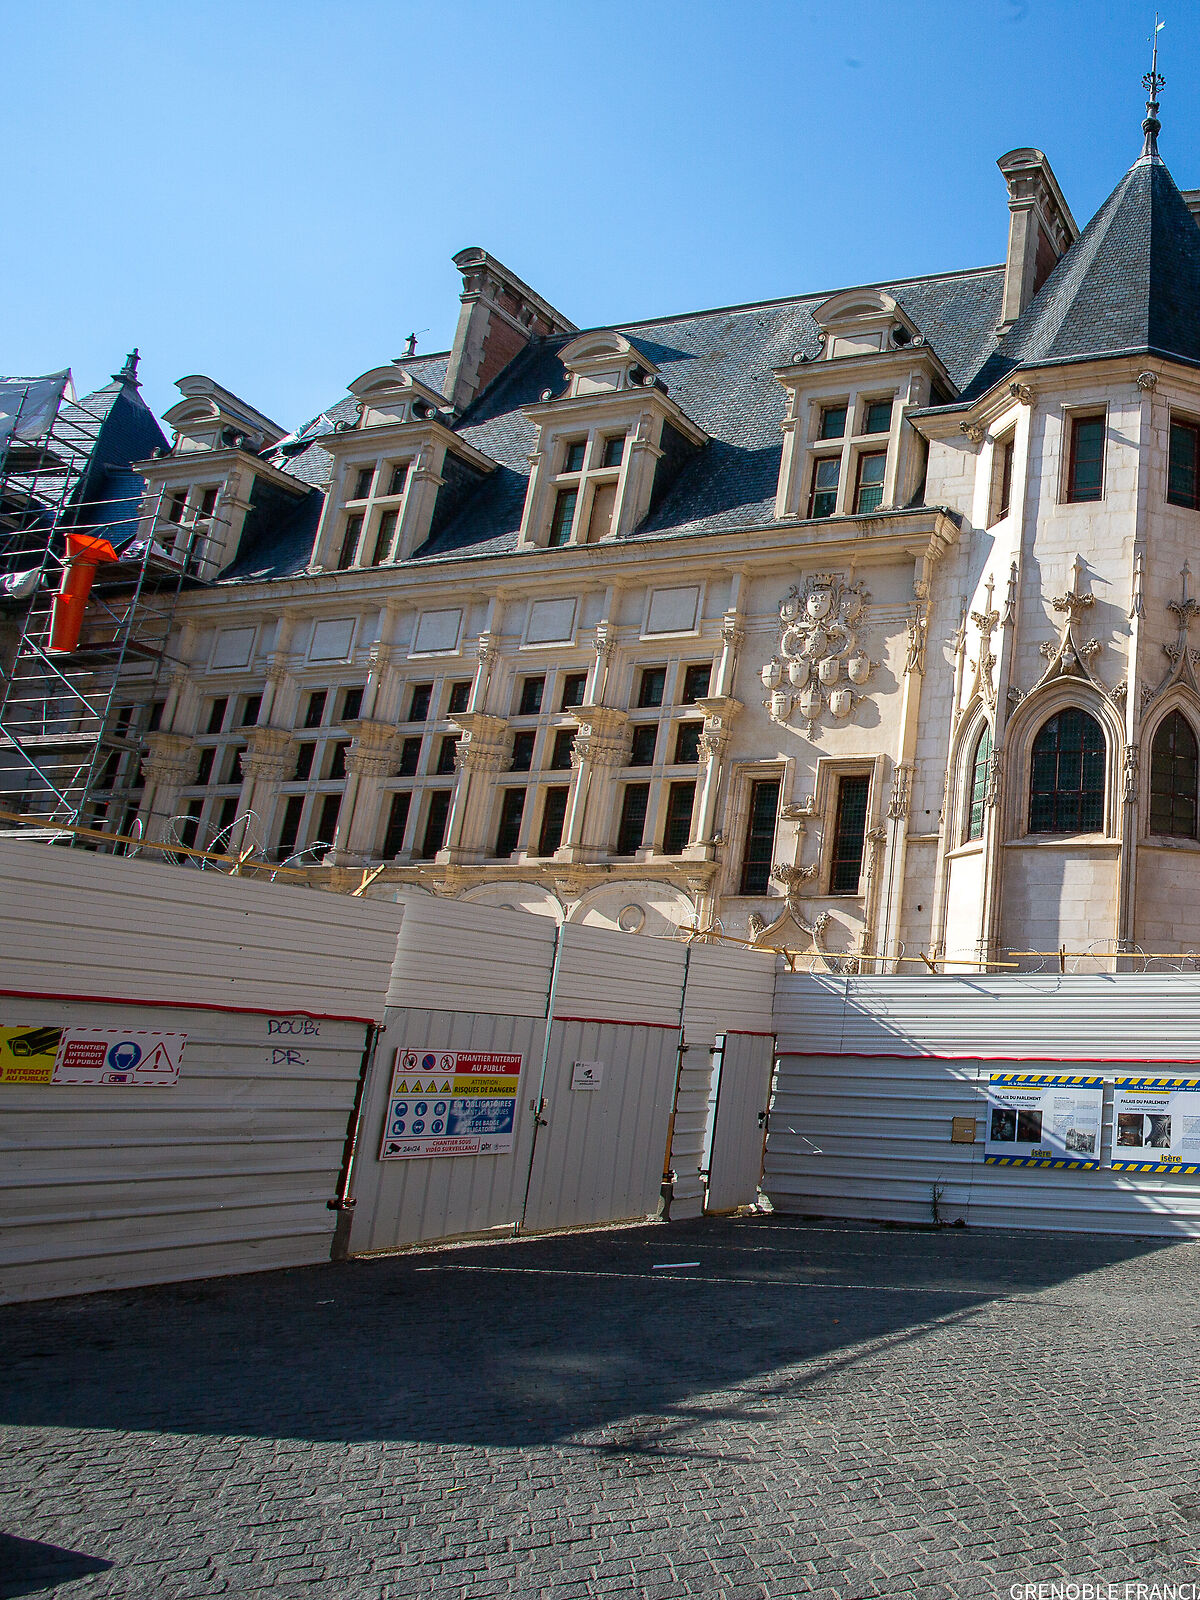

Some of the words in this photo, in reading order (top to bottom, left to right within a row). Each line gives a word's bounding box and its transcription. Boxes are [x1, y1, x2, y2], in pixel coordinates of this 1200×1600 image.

[68, 1043, 106, 1051] CHANTIER
[76, 1058, 103, 1066] PUBLIC
[457, 1054, 491, 1063] CHANTIER
[492, 1055, 521, 1064] INTERDIT
[7, 1068, 51, 1076] INTERDIT
[471, 1064, 482, 1072] AU
[482, 1064, 506, 1073] PUBLIC
[454, 1086, 480, 1094] RISQUES
[489, 1086, 516, 1094] DANGERS
[465, 1100, 512, 1108] OBLIGATOIRES
[442, 1144, 477, 1152] SURVEILLANCE
[1031, 1149, 1051, 1157] isère
[1160, 1154, 1181, 1162] isère
